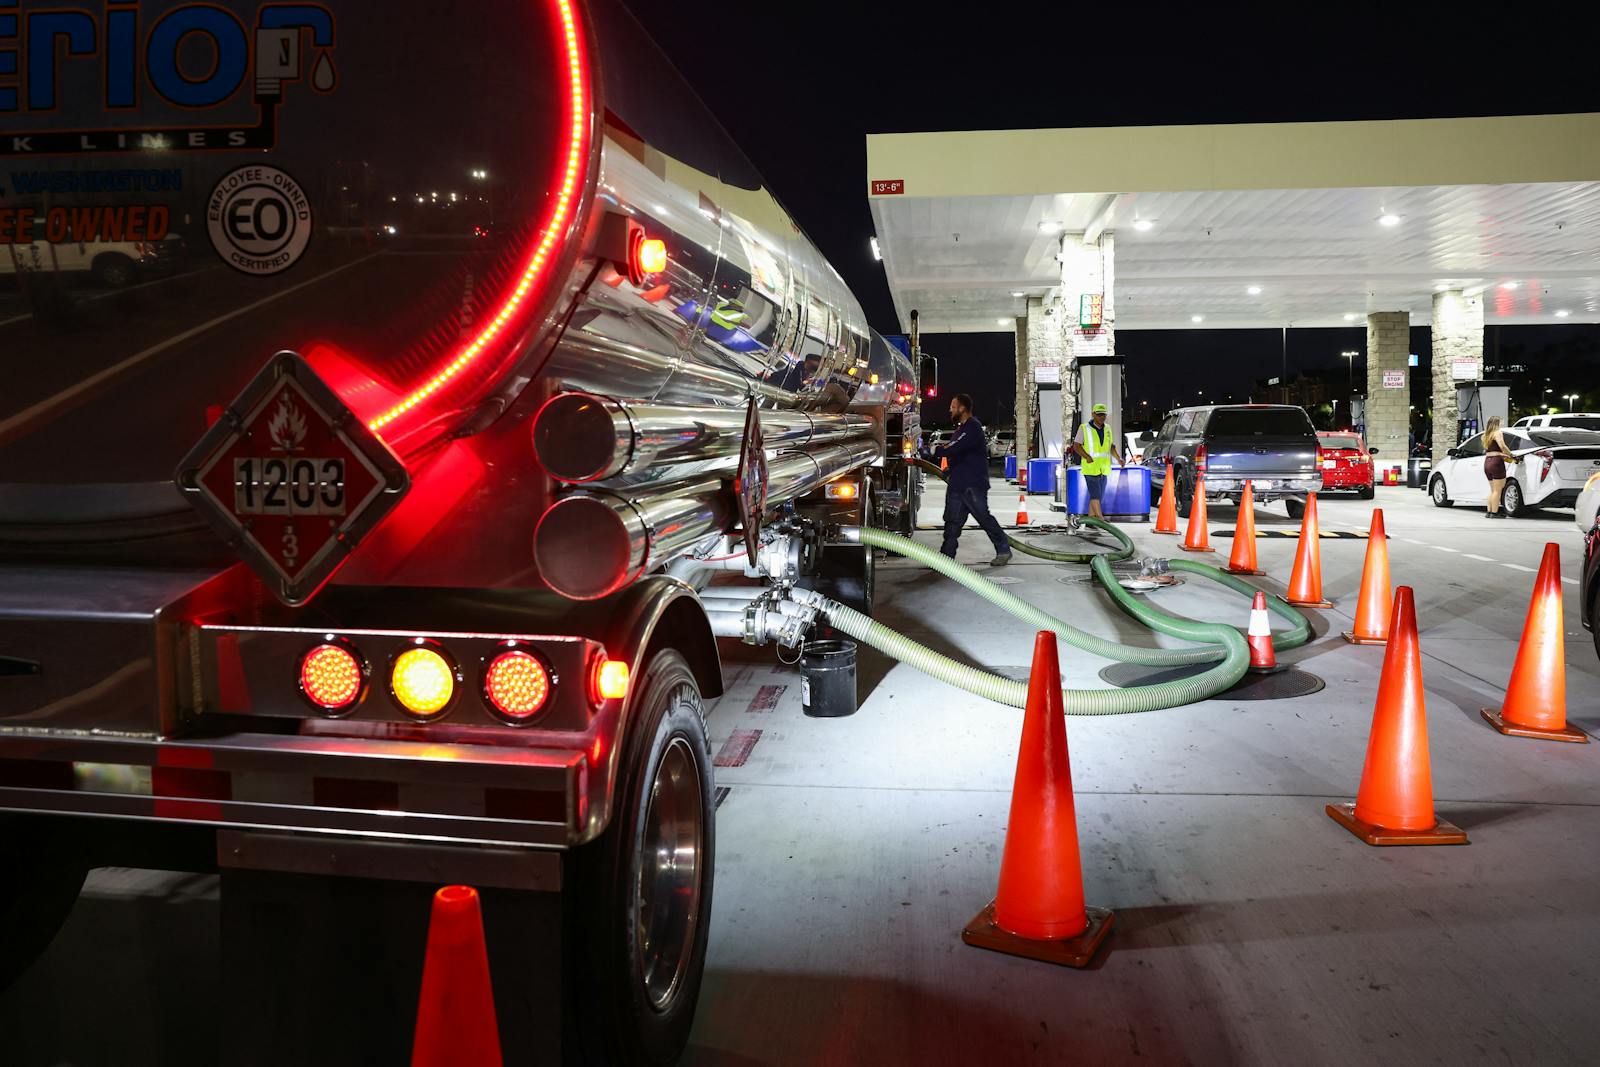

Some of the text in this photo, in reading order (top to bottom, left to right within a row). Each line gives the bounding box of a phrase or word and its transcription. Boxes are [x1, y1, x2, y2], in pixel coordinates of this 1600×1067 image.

[80, 130, 247, 150] LINES
[11, 168, 183, 194] WASHINGTON
[209, 169, 309, 222] EMPLOYEE OWNED
[45, 204, 170, 244] OWNED
[227, 197, 289, 241] EO
[231, 251, 290, 270] CERTIFIED
[239, 459, 344, 508] 1203
[281, 534, 299, 560] 3
